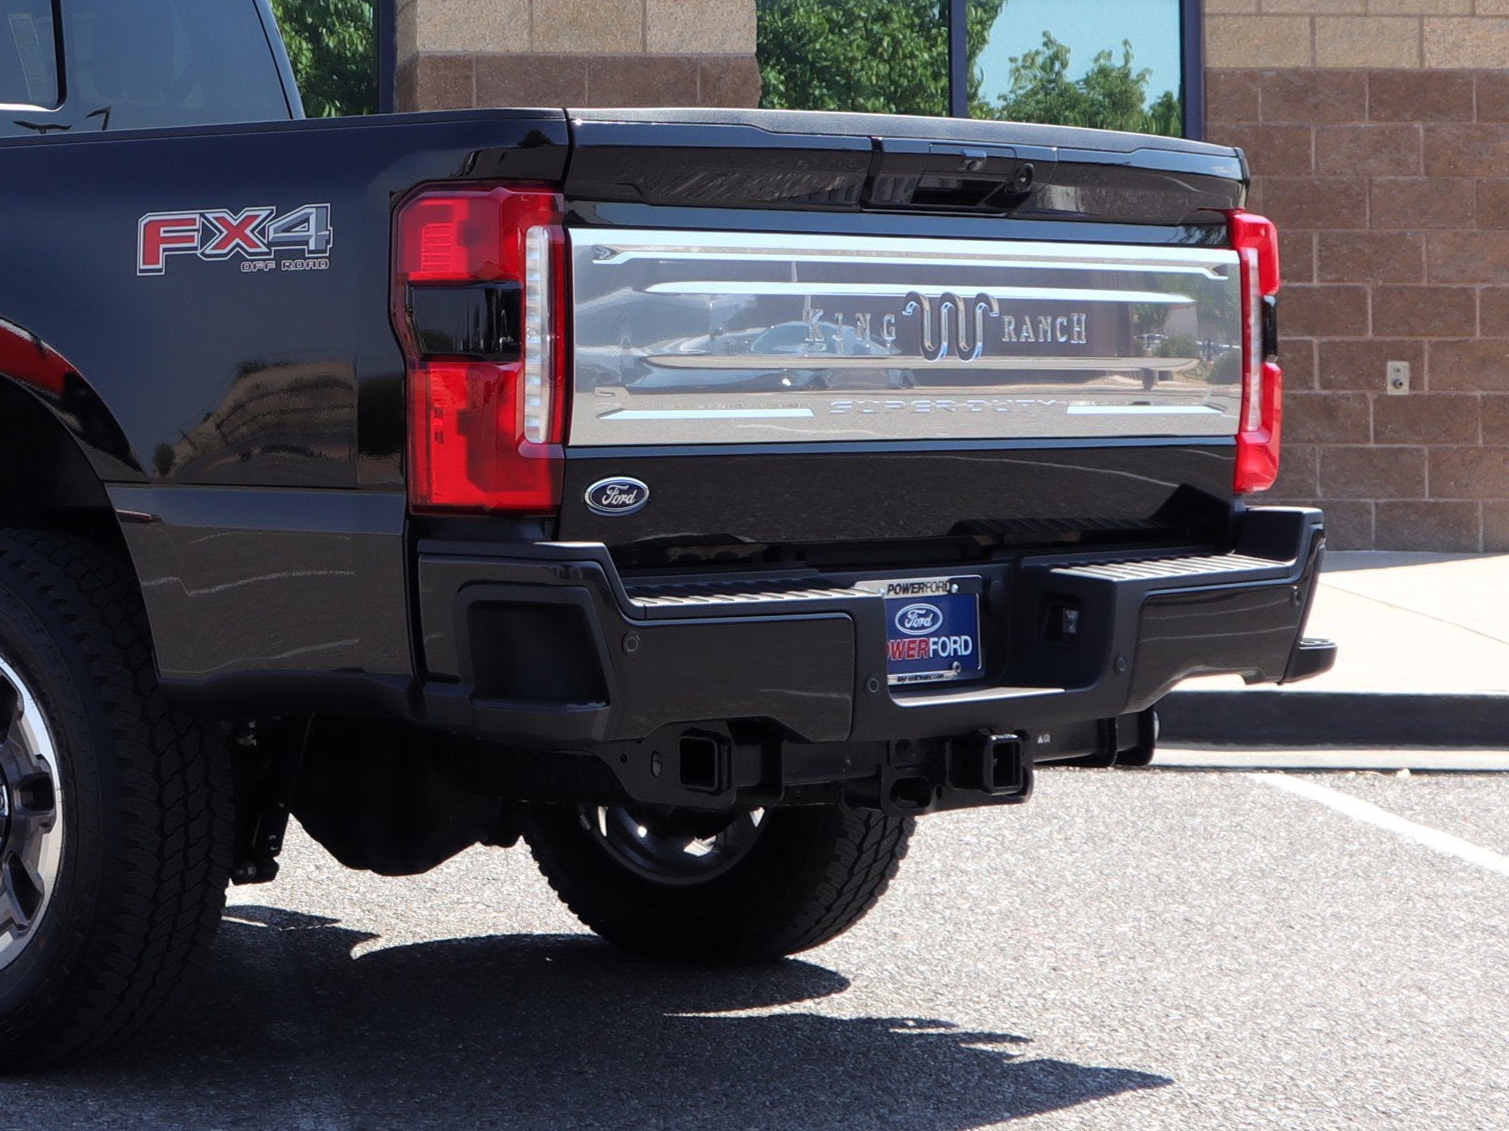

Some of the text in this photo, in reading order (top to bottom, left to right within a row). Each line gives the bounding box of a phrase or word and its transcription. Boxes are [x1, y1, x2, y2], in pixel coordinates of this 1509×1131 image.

[137, 203, 333, 276] FX4
[240, 258, 330, 272] OFF ROAD
[804, 308, 1088, 345] KING RANCH
[601, 484, 638, 505] Ford
[886, 580, 952, 596] POWERFORD
[904, 609, 933, 628] Ford
